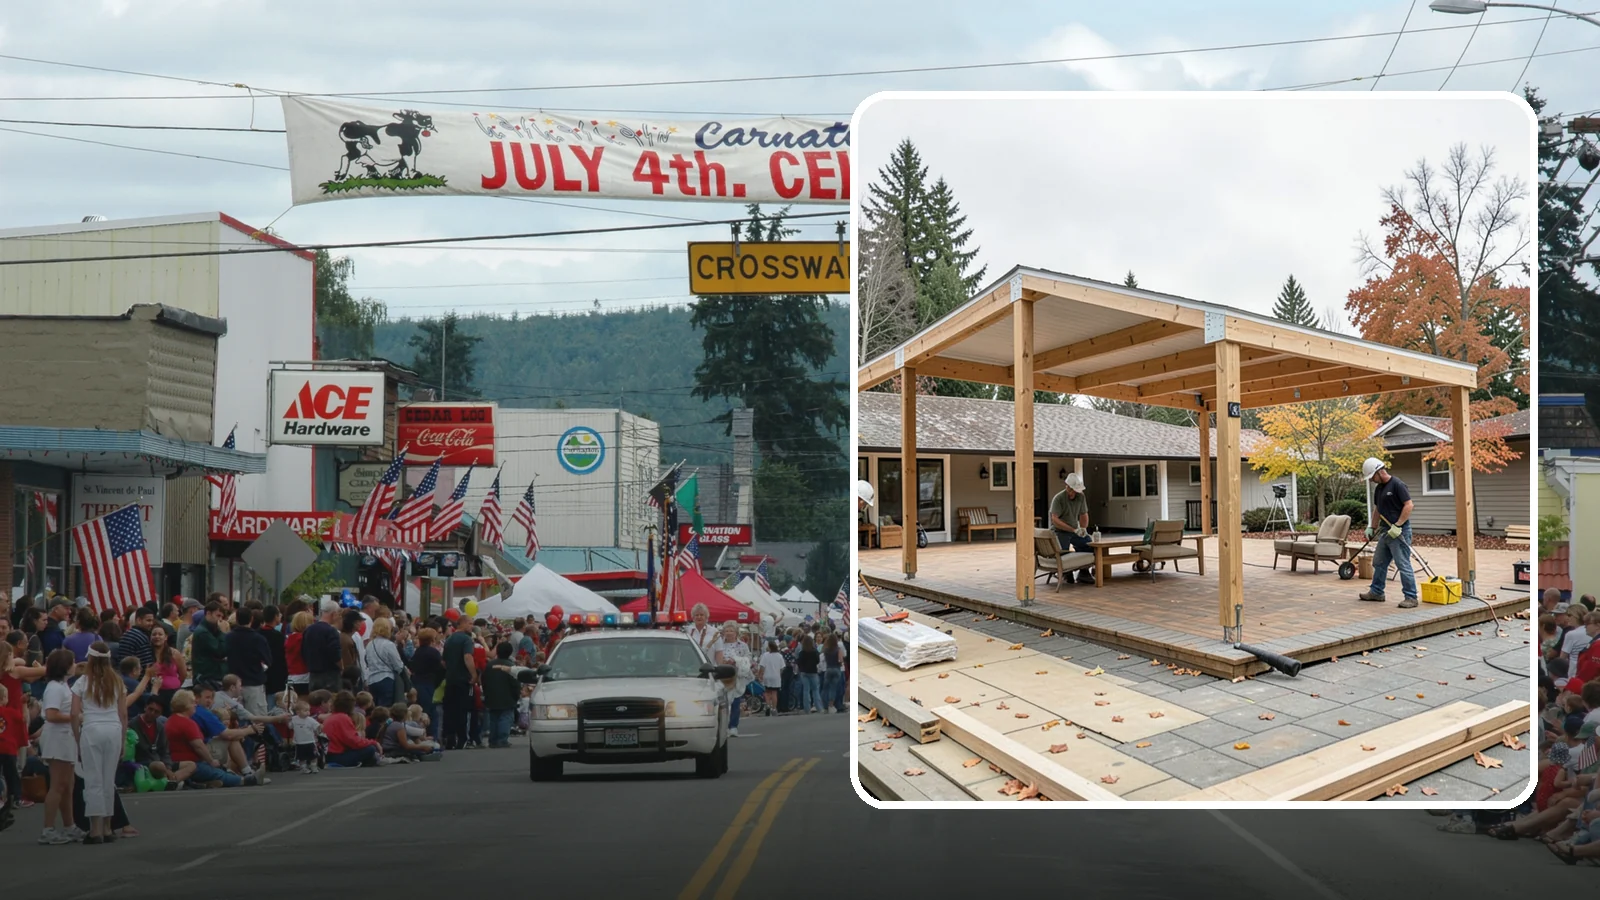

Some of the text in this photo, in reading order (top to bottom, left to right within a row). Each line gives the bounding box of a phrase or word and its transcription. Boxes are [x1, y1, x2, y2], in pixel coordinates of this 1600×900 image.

[480, 140, 605, 192] JULY
[632, 149, 747, 198] 4th.
[697, 253, 850, 280] CROSSWA
[282, 380, 374, 420] ACE
[405, 409, 453, 422] CEDAR
[283, 421, 371, 437] Hardware
[353, 467, 385, 479] Simpl
[83, 484, 155, 495] St. Vincent de Paul
[688, 526, 741, 535] CRNATION
[699, 535, 730, 544] GLASS
